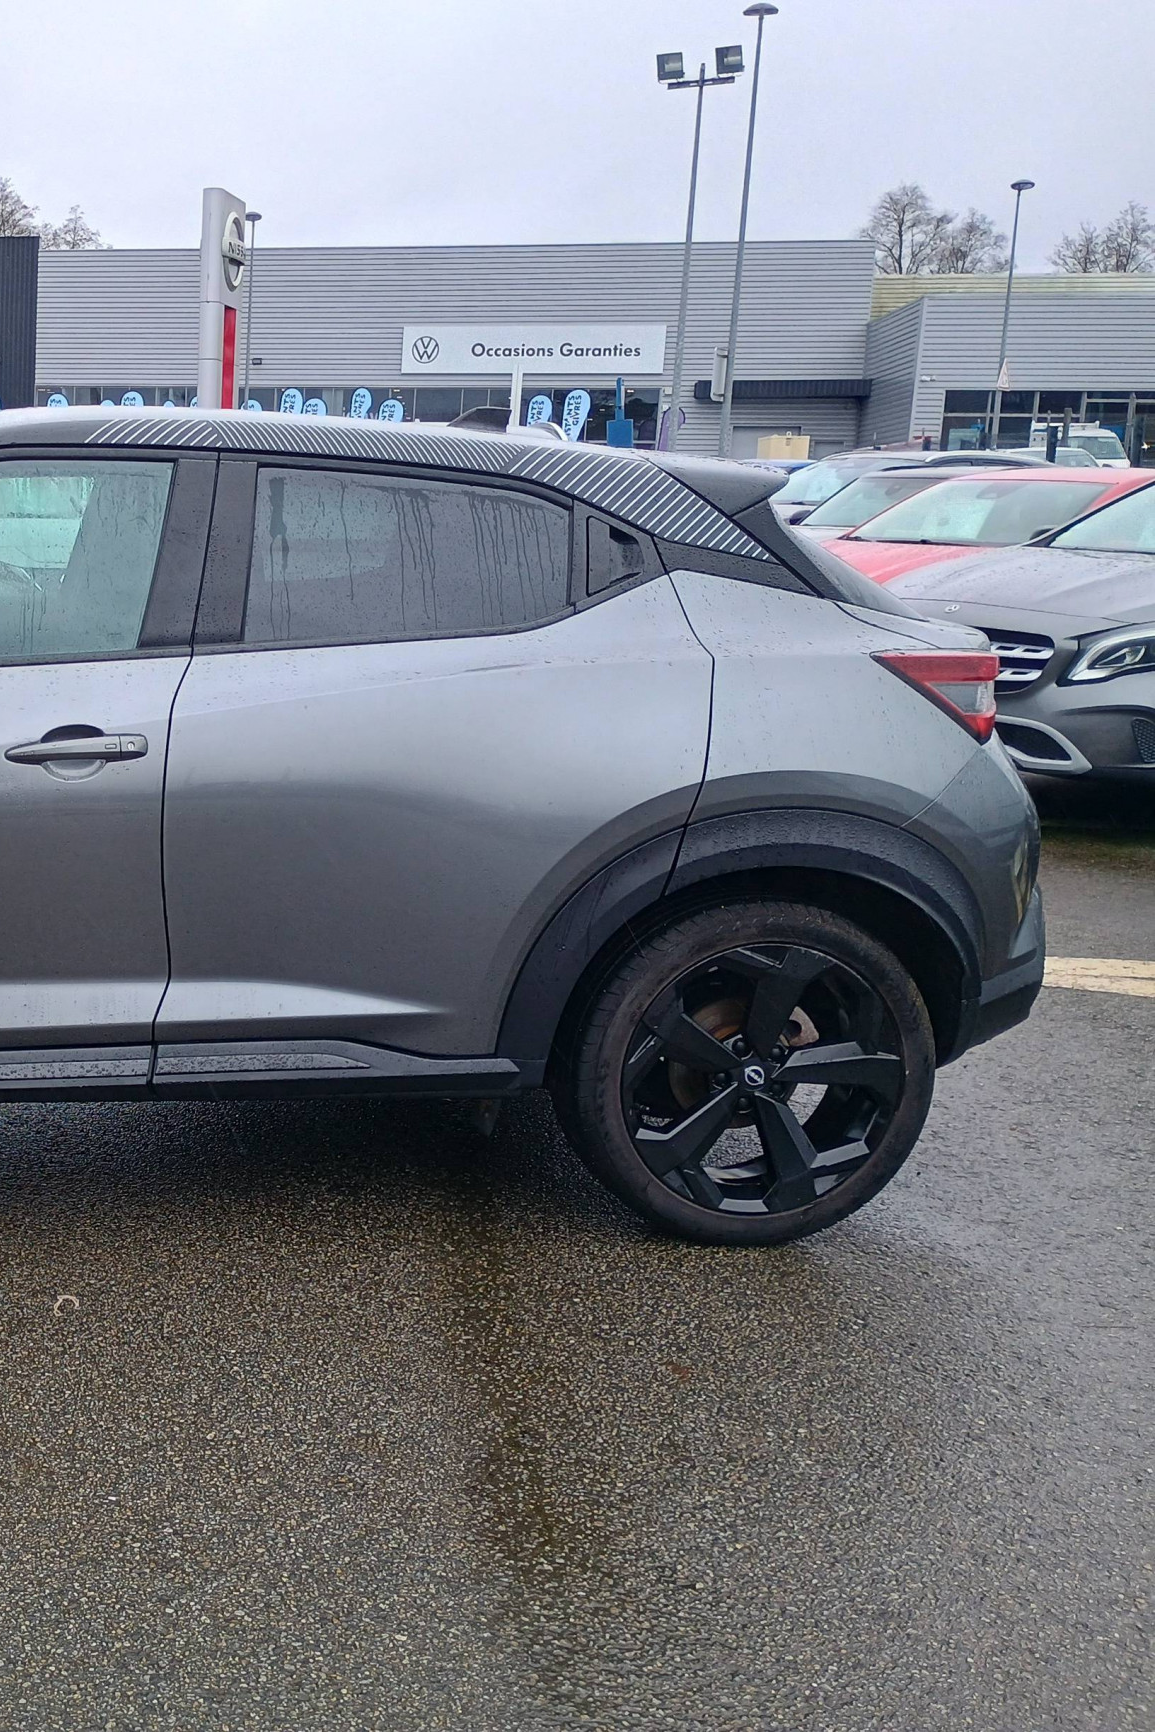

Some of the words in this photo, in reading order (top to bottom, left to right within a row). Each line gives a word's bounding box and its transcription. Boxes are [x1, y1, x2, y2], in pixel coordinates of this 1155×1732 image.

[228, 241, 246, 259] NISS
[471, 342, 554, 358] Occasions
[559, 342, 641, 358] Garanties
